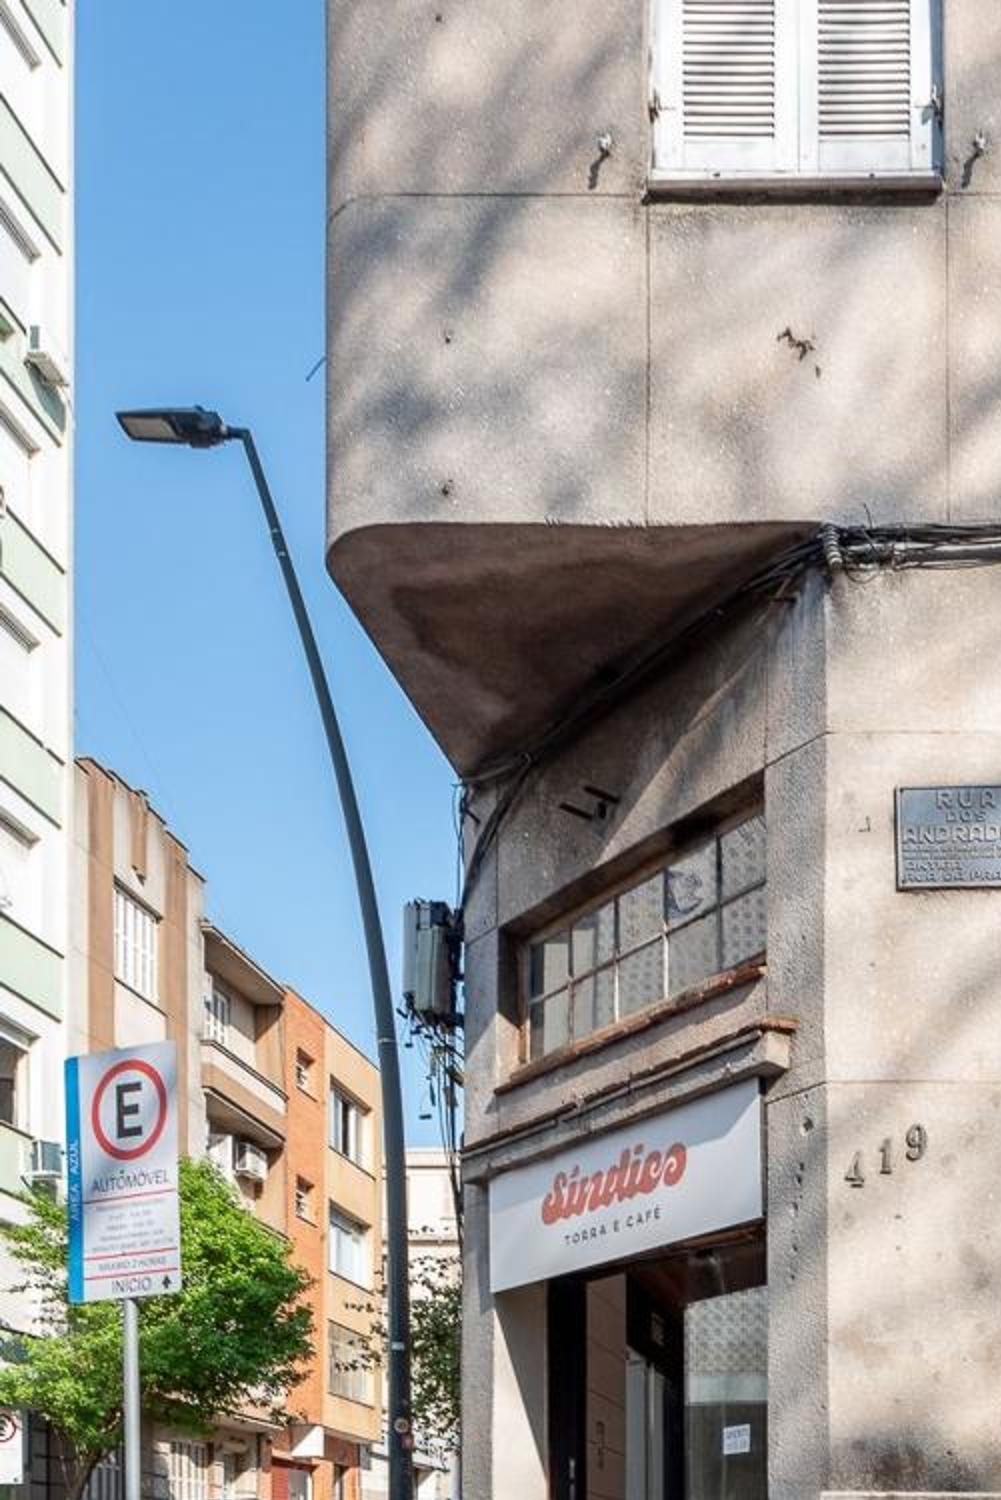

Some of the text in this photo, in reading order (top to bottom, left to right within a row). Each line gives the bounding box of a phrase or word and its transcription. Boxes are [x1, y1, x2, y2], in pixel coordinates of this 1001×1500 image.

[115, 1081, 143, 1139] E
[541, 1143, 687, 1225] Síndico
[844, 1123, 928, 1189] 419
[564, 1224, 607, 1245] TORRA
[613, 1219, 620, 1233] E
